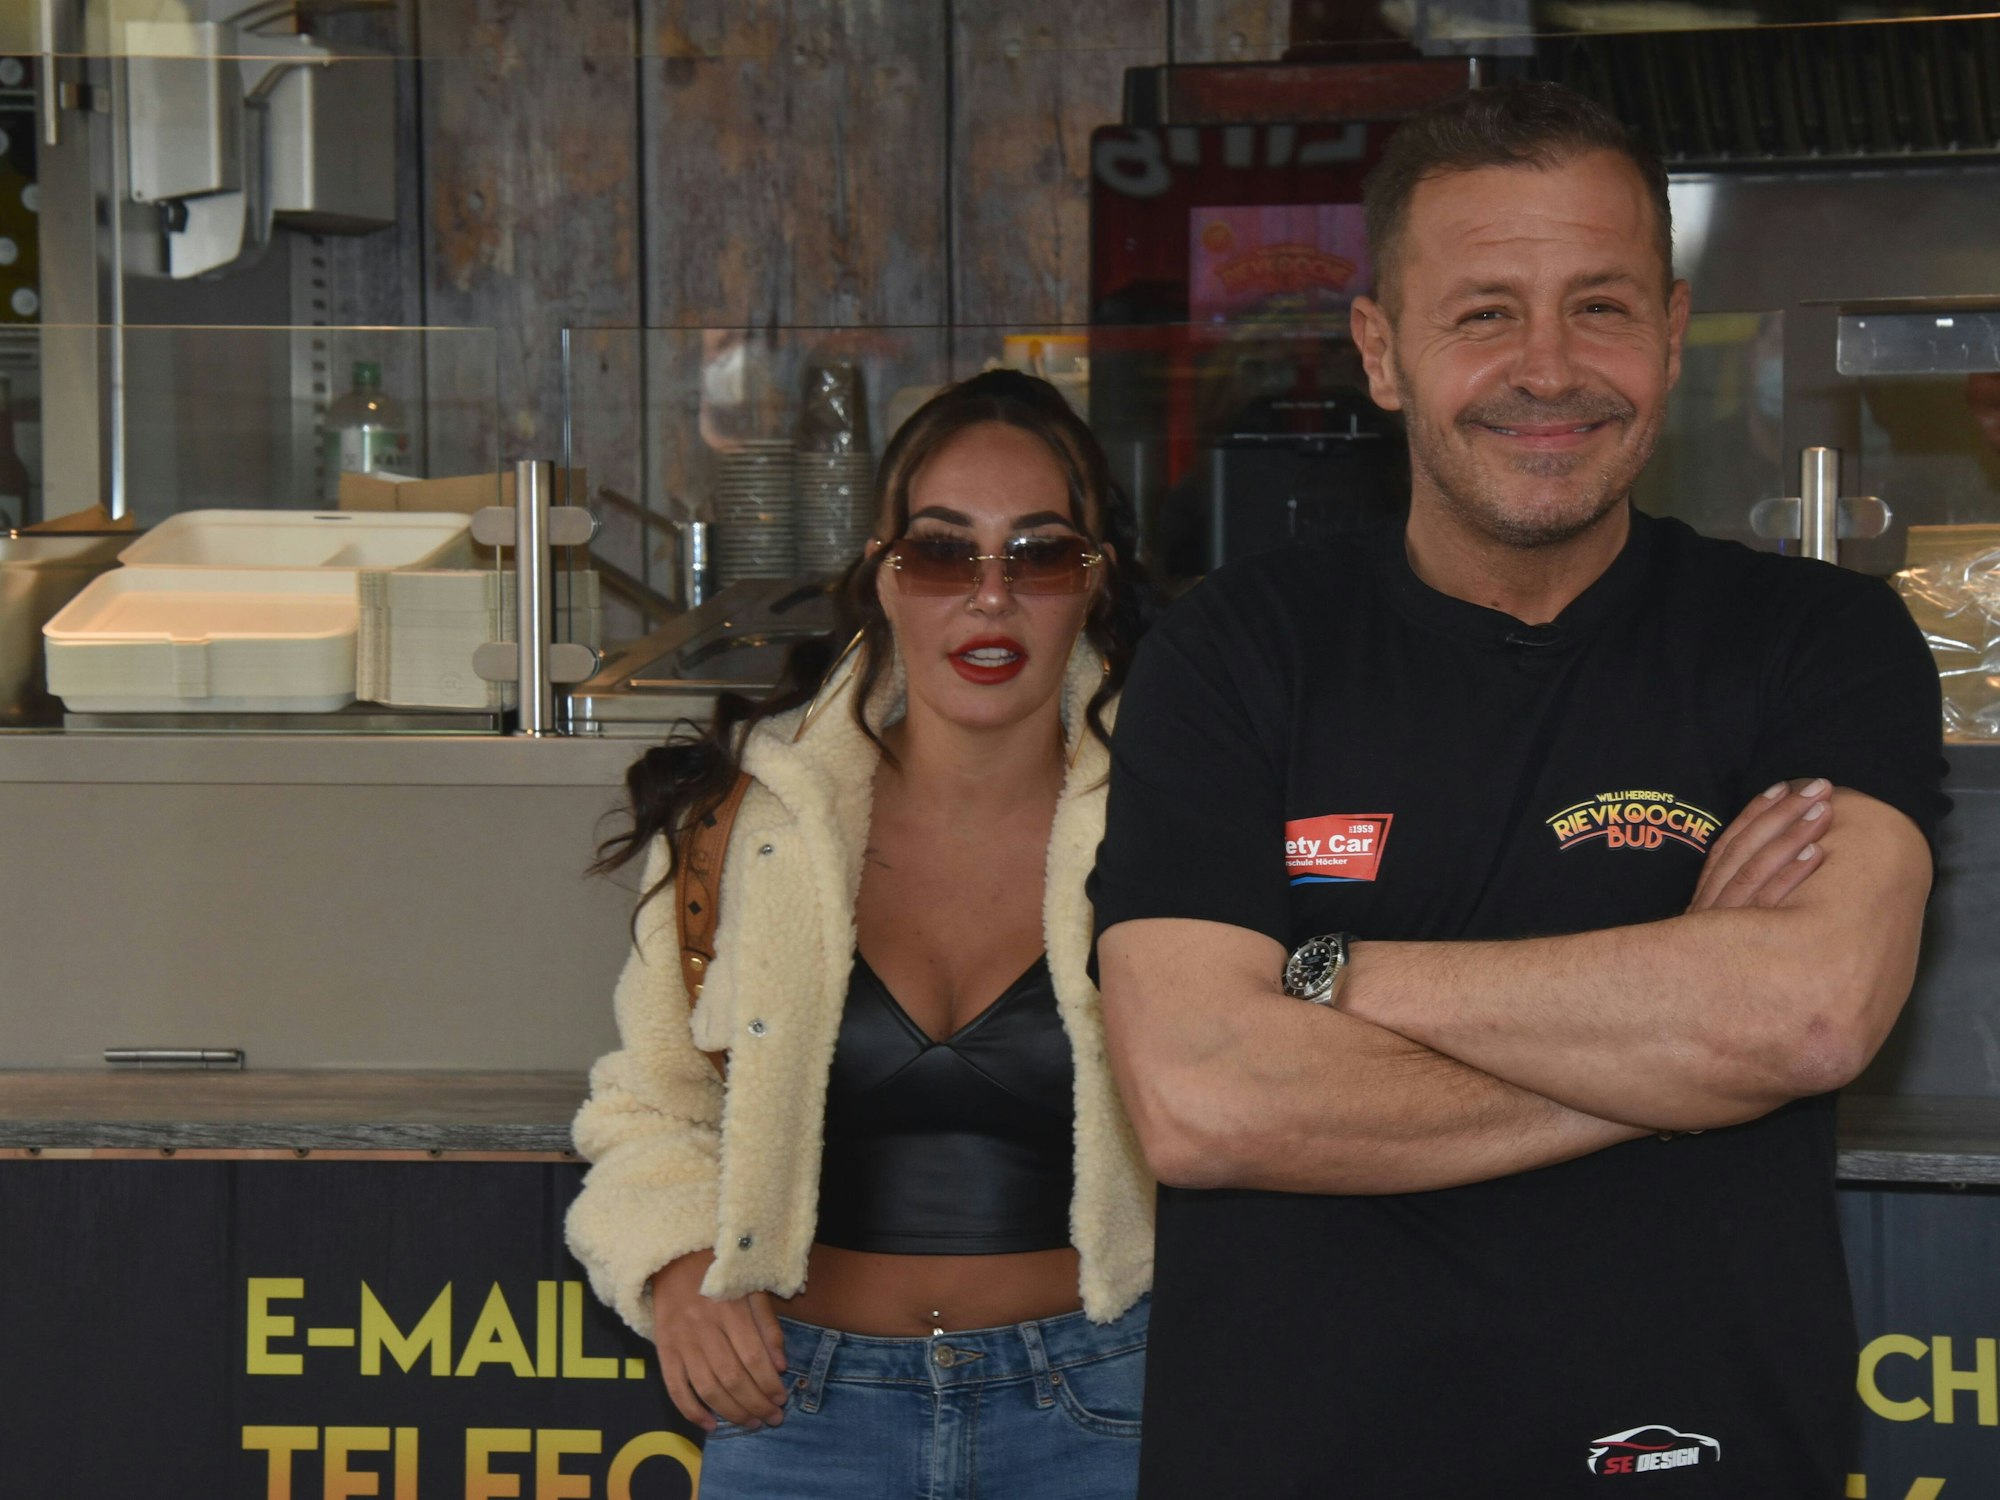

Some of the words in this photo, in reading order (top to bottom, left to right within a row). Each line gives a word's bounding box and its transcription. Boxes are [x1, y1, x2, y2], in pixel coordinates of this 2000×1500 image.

[1596, 791, 1624, 803] WILLI
[1625, 790, 1674, 804] HERREN'S
[1353, 825, 1374, 834] 1959
[1552, 803, 1716, 845] RIEVKOOCHE
[1285, 836, 1321, 858] ety
[1328, 835, 1373, 853] Car
[1608, 825, 1663, 849] BUD
[1315, 857, 1348, 866] Höcker
[1603, 1455, 1634, 1475] SE
[1634, 1446, 1700, 1473] DESIGN
